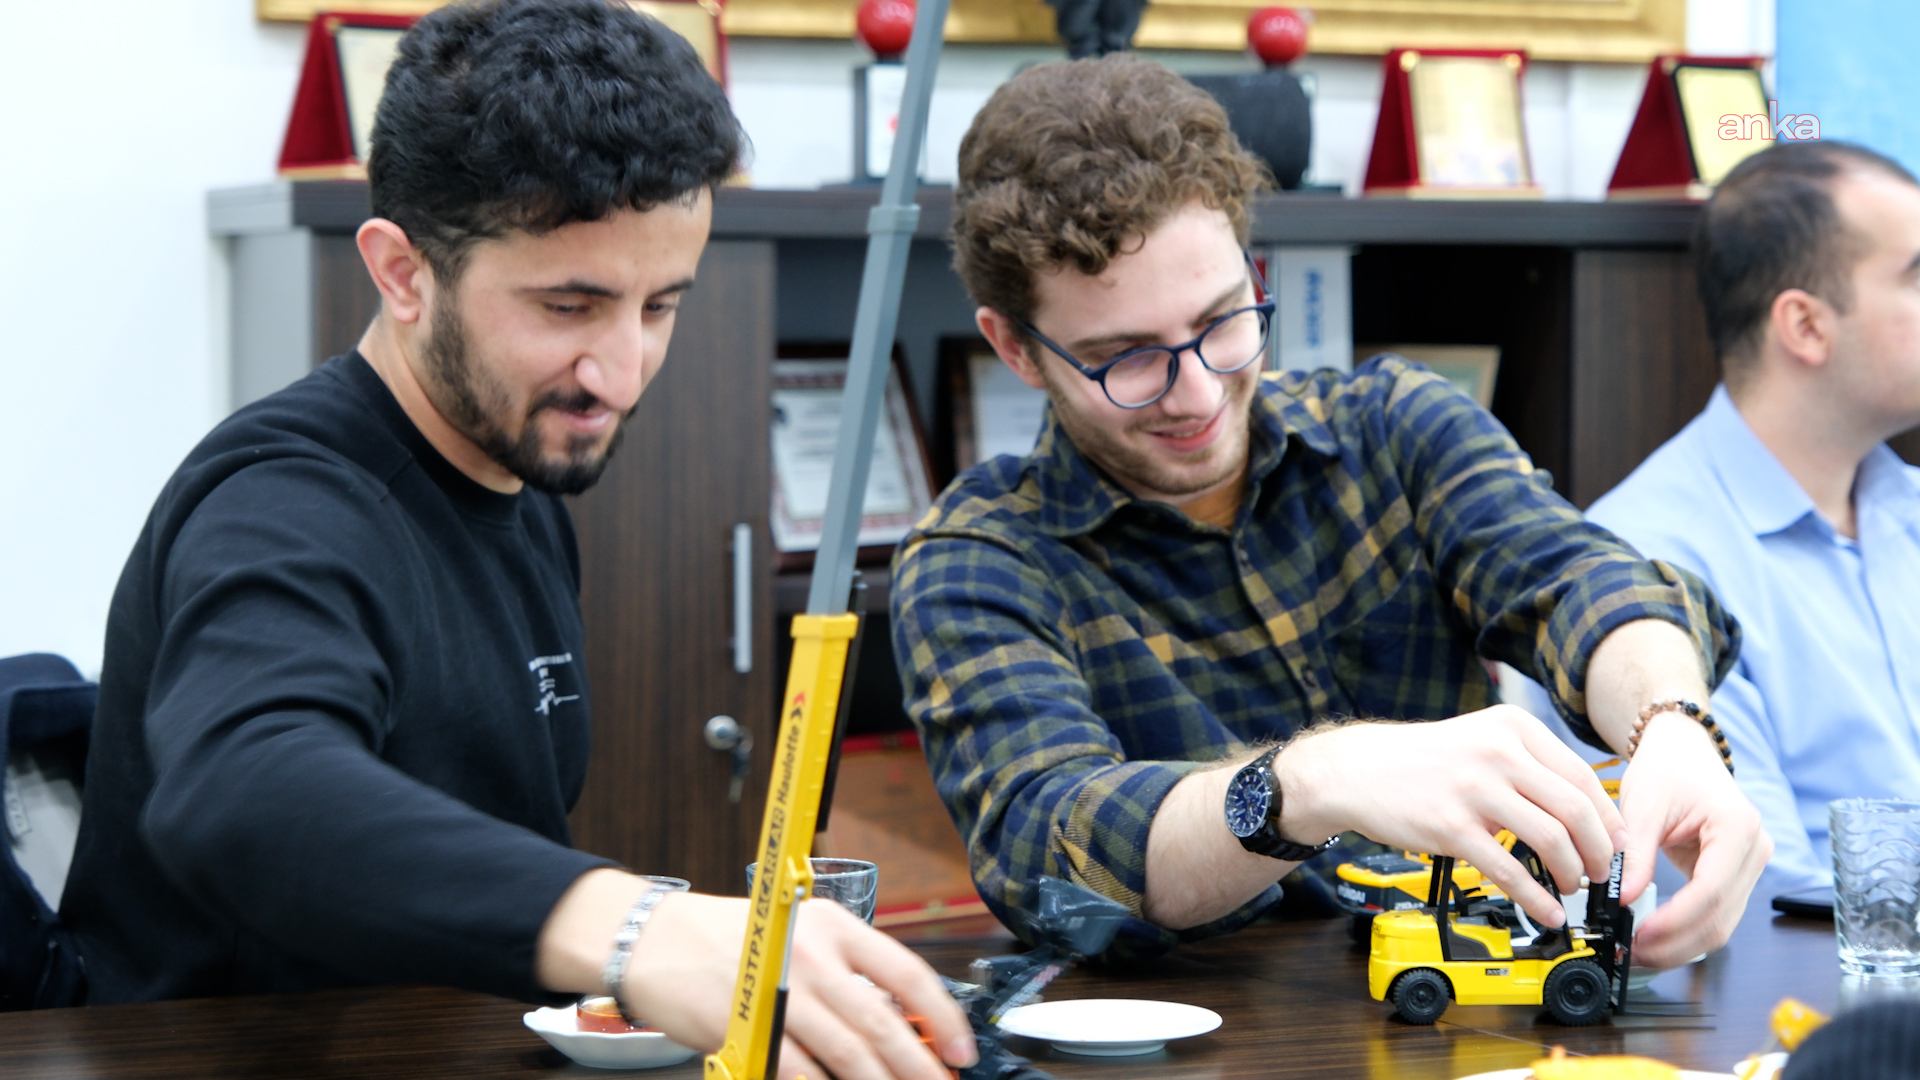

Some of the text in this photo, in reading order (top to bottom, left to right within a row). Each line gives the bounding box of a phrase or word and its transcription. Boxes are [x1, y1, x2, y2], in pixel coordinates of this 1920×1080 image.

[738, 724, 800, 1022] H43TPX ACARLAR Haulotte
